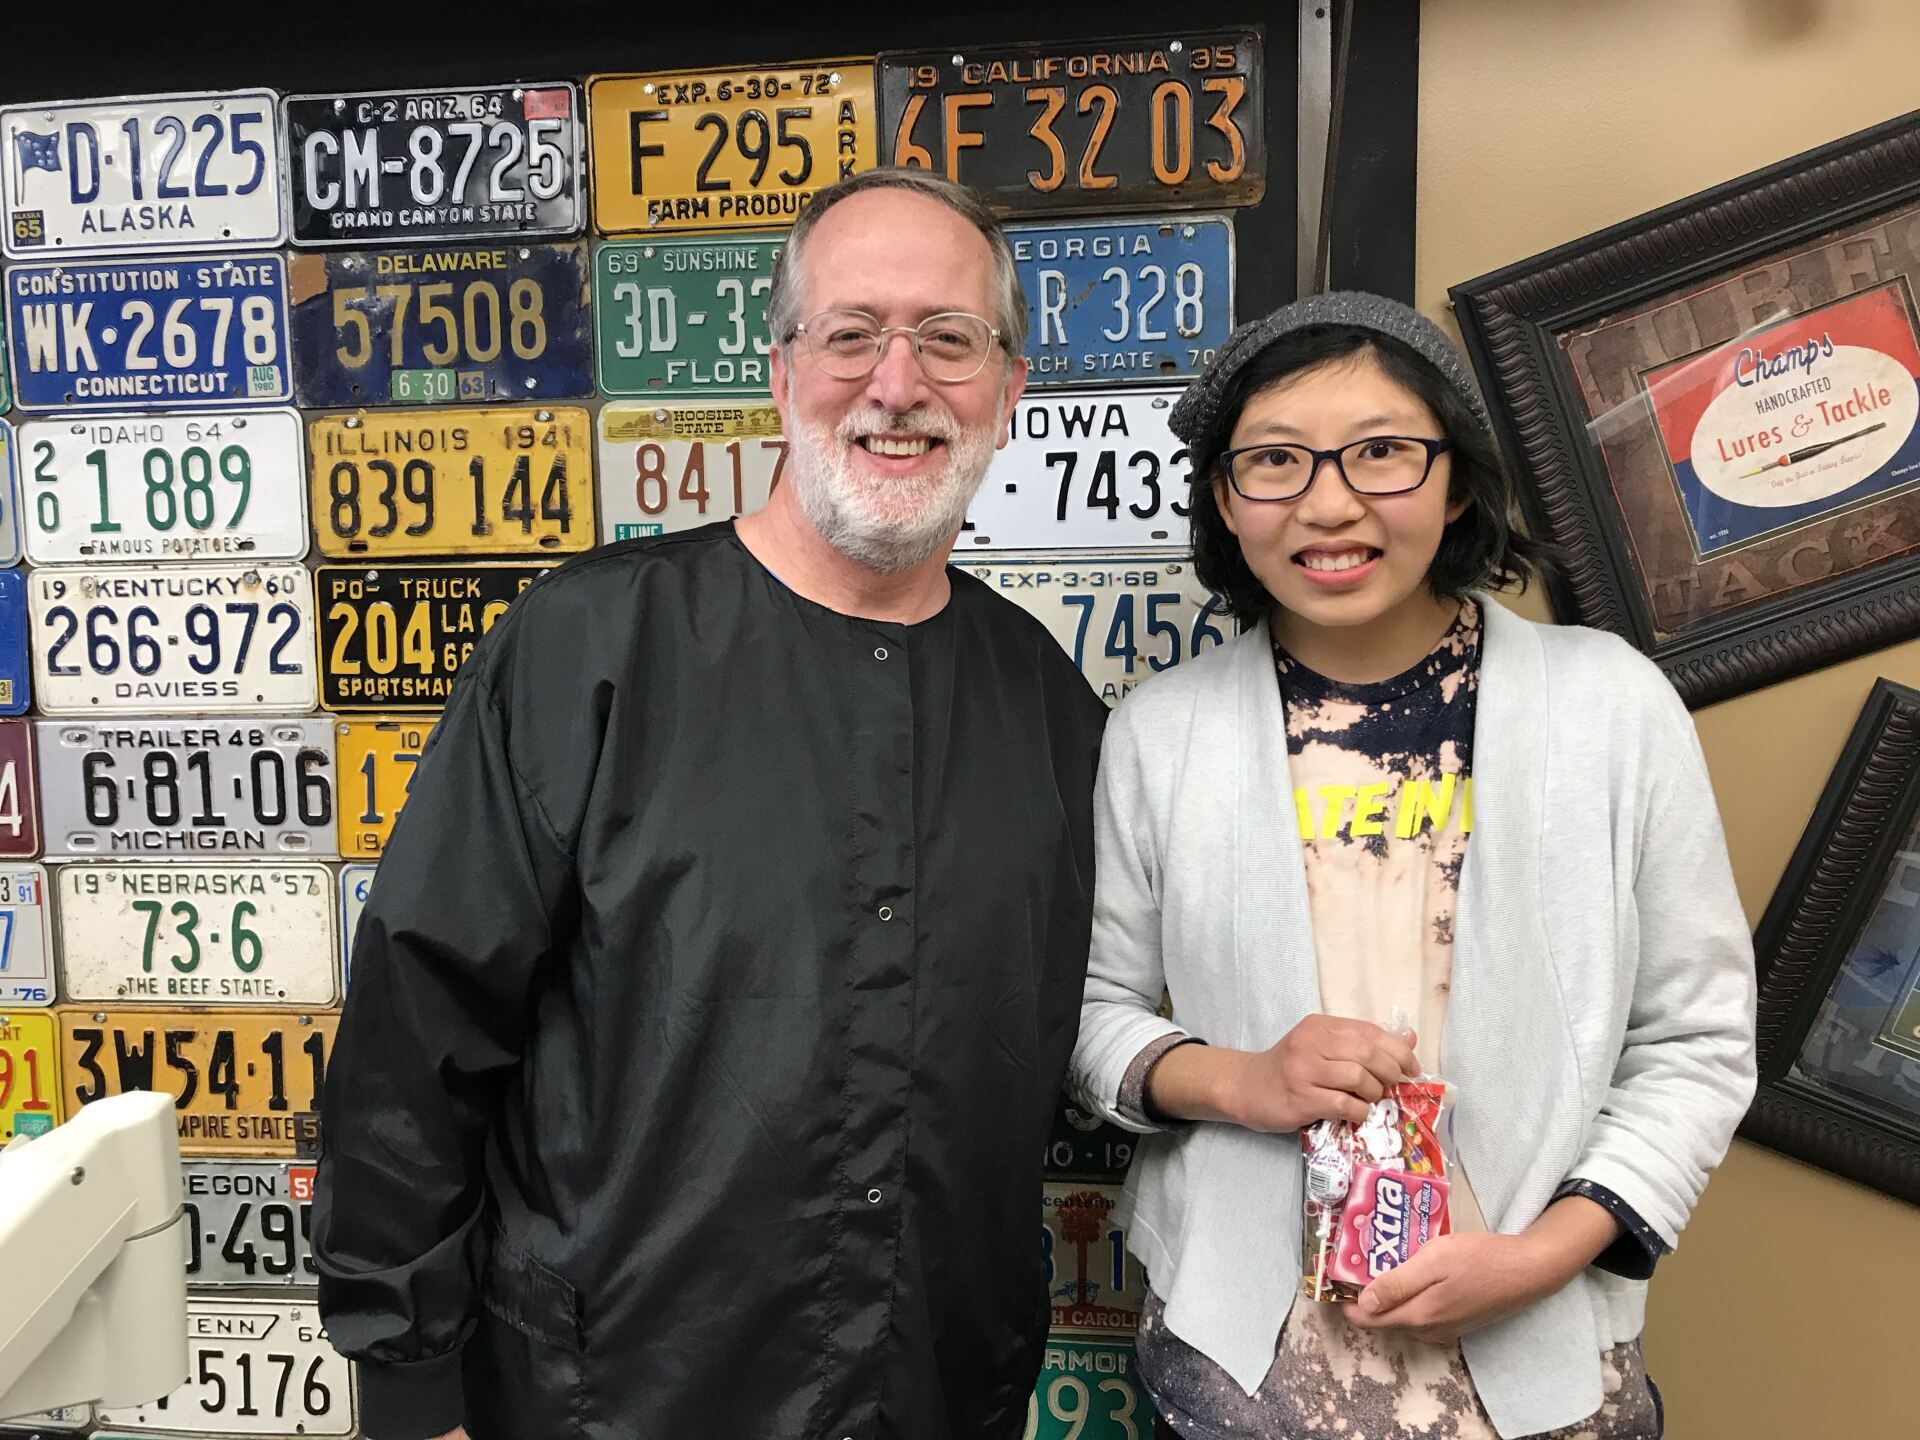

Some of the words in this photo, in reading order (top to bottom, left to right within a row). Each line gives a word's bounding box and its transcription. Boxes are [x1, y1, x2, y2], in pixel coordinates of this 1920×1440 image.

[908, 66, 938, 88] 19
[962, 51, 1169, 85] CALIFORNIA
[1191, 46, 1236, 70] 35
[471, 96, 504, 118] 64
[894, 92, 993, 183] 6F
[1026, 85, 1119, 191] 32
[1151, 76, 1246, 186] 03
[629, 110, 668, 195] F
[695, 107, 813, 192] 295
[304, 119, 564, 210] CM-8725
[81, 204, 195, 233] ALASKA
[332, 211, 393, 228] GRAND
[399, 208, 474, 226] CANYON
[479, 203, 536, 223] STATE
[648, 197, 709, 221] FARM
[15, 220, 42, 238] 65
[1014, 235, 1152, 261] EORGIA
[377, 251, 507, 274] DELAWARE
[608, 254, 639, 273] 69
[663, 250, 759, 272] SUNSHINE
[17, 269, 179, 296] CONSTITUTION
[198, 265, 274, 288] STATE
[1039, 269, 1069, 346] R
[1102, 263, 1204, 342] 328
[333, 277, 547, 369] 57508
[1083, 351, 1154, 371] STATE
[1735, 331, 1834, 388] Champs
[76, 372, 228, 397] CONNECTICUT
[253, 366, 274, 381] AUG
[667, 361, 772, 384] FLOR
[1755, 377, 1832, 415] HANDCRAFTED
[673, 409, 744, 421] HOOSIER
[1010, 404, 1129, 439] IOWA
[1717, 426, 1783, 463] Lures
[1791, 414, 1814, 438] &
[1816, 383, 1892, 426] Tackle
[91, 423, 164, 444] IDAHO
[186, 422, 222, 442] 64
[326, 427, 469, 456] ILLINOIS
[504, 424, 573, 449] 1941
[673, 423, 724, 434] STATE
[85, 448, 122, 533] 1
[143, 444, 251, 531] 889
[636, 441, 790, 515] 8417
[329, 458, 435, 539] 839
[468, 453, 571, 536] 144
[90, 539, 153, 554] FAMOUS
[43, 580, 66, 599] 19
[96, 576, 241, 598] KENTUCKY
[265, 576, 295, 596] 60
[400, 578, 481, 598] TRUCK
[442, 604, 475, 633] LA
[328, 600, 434, 675] 204
[1062, 593, 1223, 673] 7456
[115, 681, 239, 698] DAVIESS
[100, 729, 221, 748] TRAILER
[228, 729, 265, 746] 48
[110, 830, 265, 850] MICHIGAN
[74, 873, 99, 894] 19
[122, 873, 265, 895] NEBRASKA
[284, 874, 315, 895] 57
[126, 976, 158, 994] THE
[168, 977, 211, 995] BEEF
[220, 978, 275, 996] STATE
[237, 1116, 295, 1140] STATE
[189, 1175, 276, 1196] EGON
[1420, 1181, 1432, 1213] BUBBLE
[1403, 1193, 1411, 1218] FLAVOR
[1402, 1218, 1410, 1241] LASTING
[1417, 1214, 1430, 1247] CLASSIC
[1400, 1242, 1408, 1260] LONG
